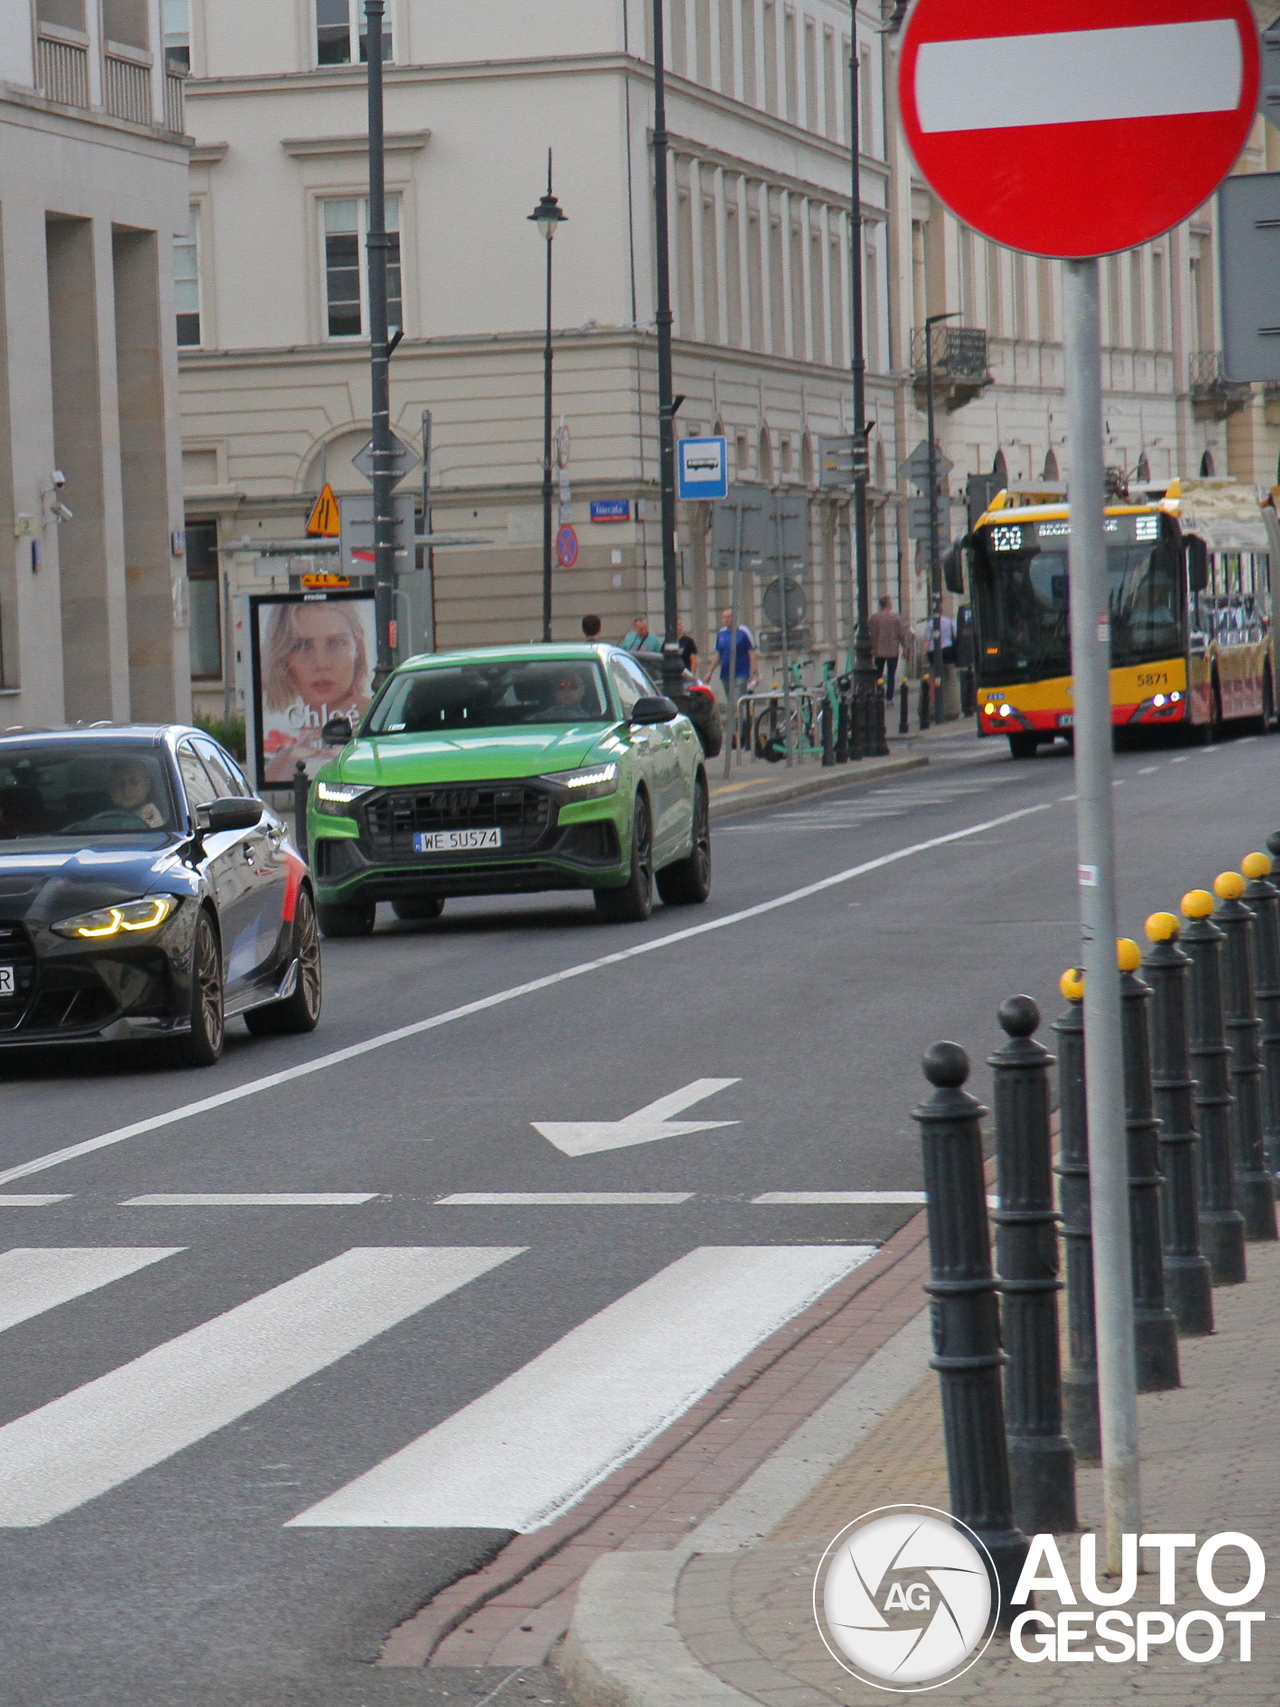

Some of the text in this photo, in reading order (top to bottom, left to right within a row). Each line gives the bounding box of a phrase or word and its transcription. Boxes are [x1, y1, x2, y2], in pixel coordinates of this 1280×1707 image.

[1137, 673, 1168, 687] 5871
[424, 833, 444, 849] WE
[450, 830, 498, 848] 5U574
